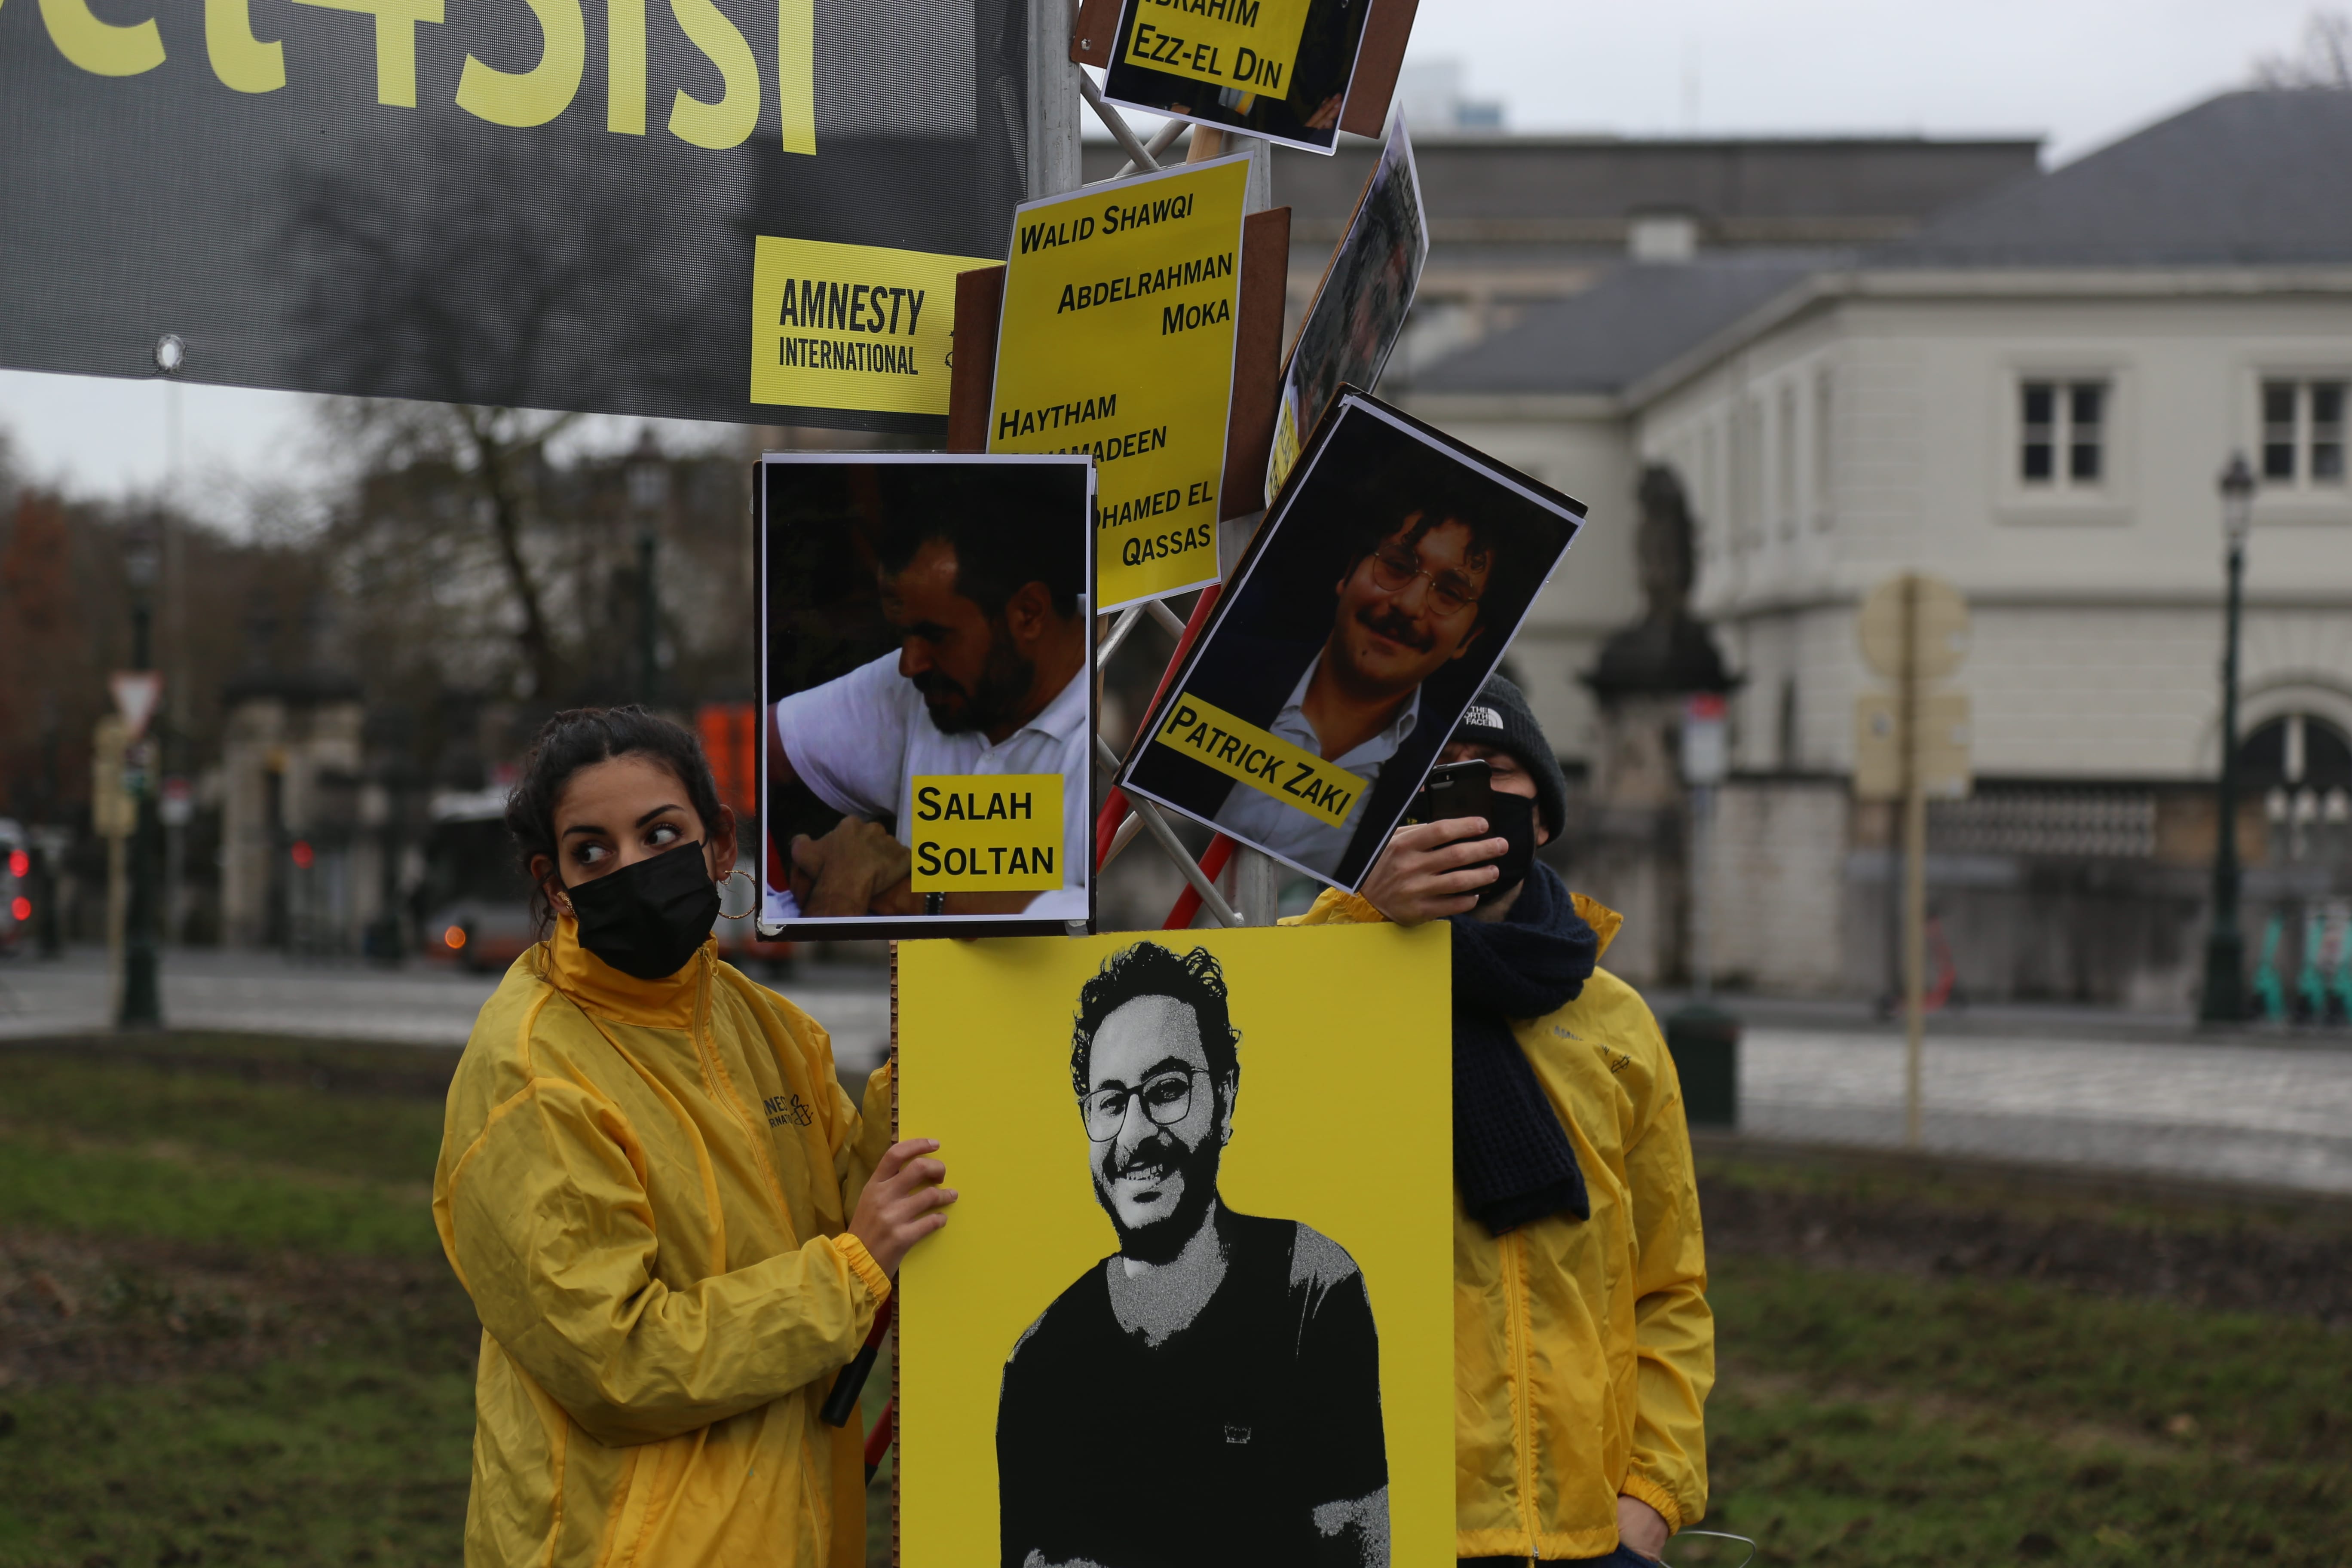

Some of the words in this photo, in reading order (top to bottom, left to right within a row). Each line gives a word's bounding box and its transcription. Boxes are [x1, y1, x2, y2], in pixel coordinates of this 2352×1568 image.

[1133, 23, 1221, 75] EZZ-EL
[1233, 47, 1282, 89] DIN
[1022, 217, 1094, 254] WALID
[1102, 193, 1193, 234] SHAWQI
[1057, 253, 1231, 314] ABDELRAHMAN
[780, 279, 925, 335] AMNESTY
[1163, 299, 1229, 335] MOKA
[780, 337, 918, 375] INTERNATIONAL
[999, 394, 1116, 440] HAYTHAM
[1188, 481, 1213, 506] EL
[1123, 524, 1210, 566] QASSAS
[1466, 718, 1488, 726] FACE
[1167, 705, 1285, 784] PATRICK
[1283, 763, 1351, 815] ZAKI
[918, 787, 1031, 821] SALAH
[918, 842, 1053, 876] SOLTAN
